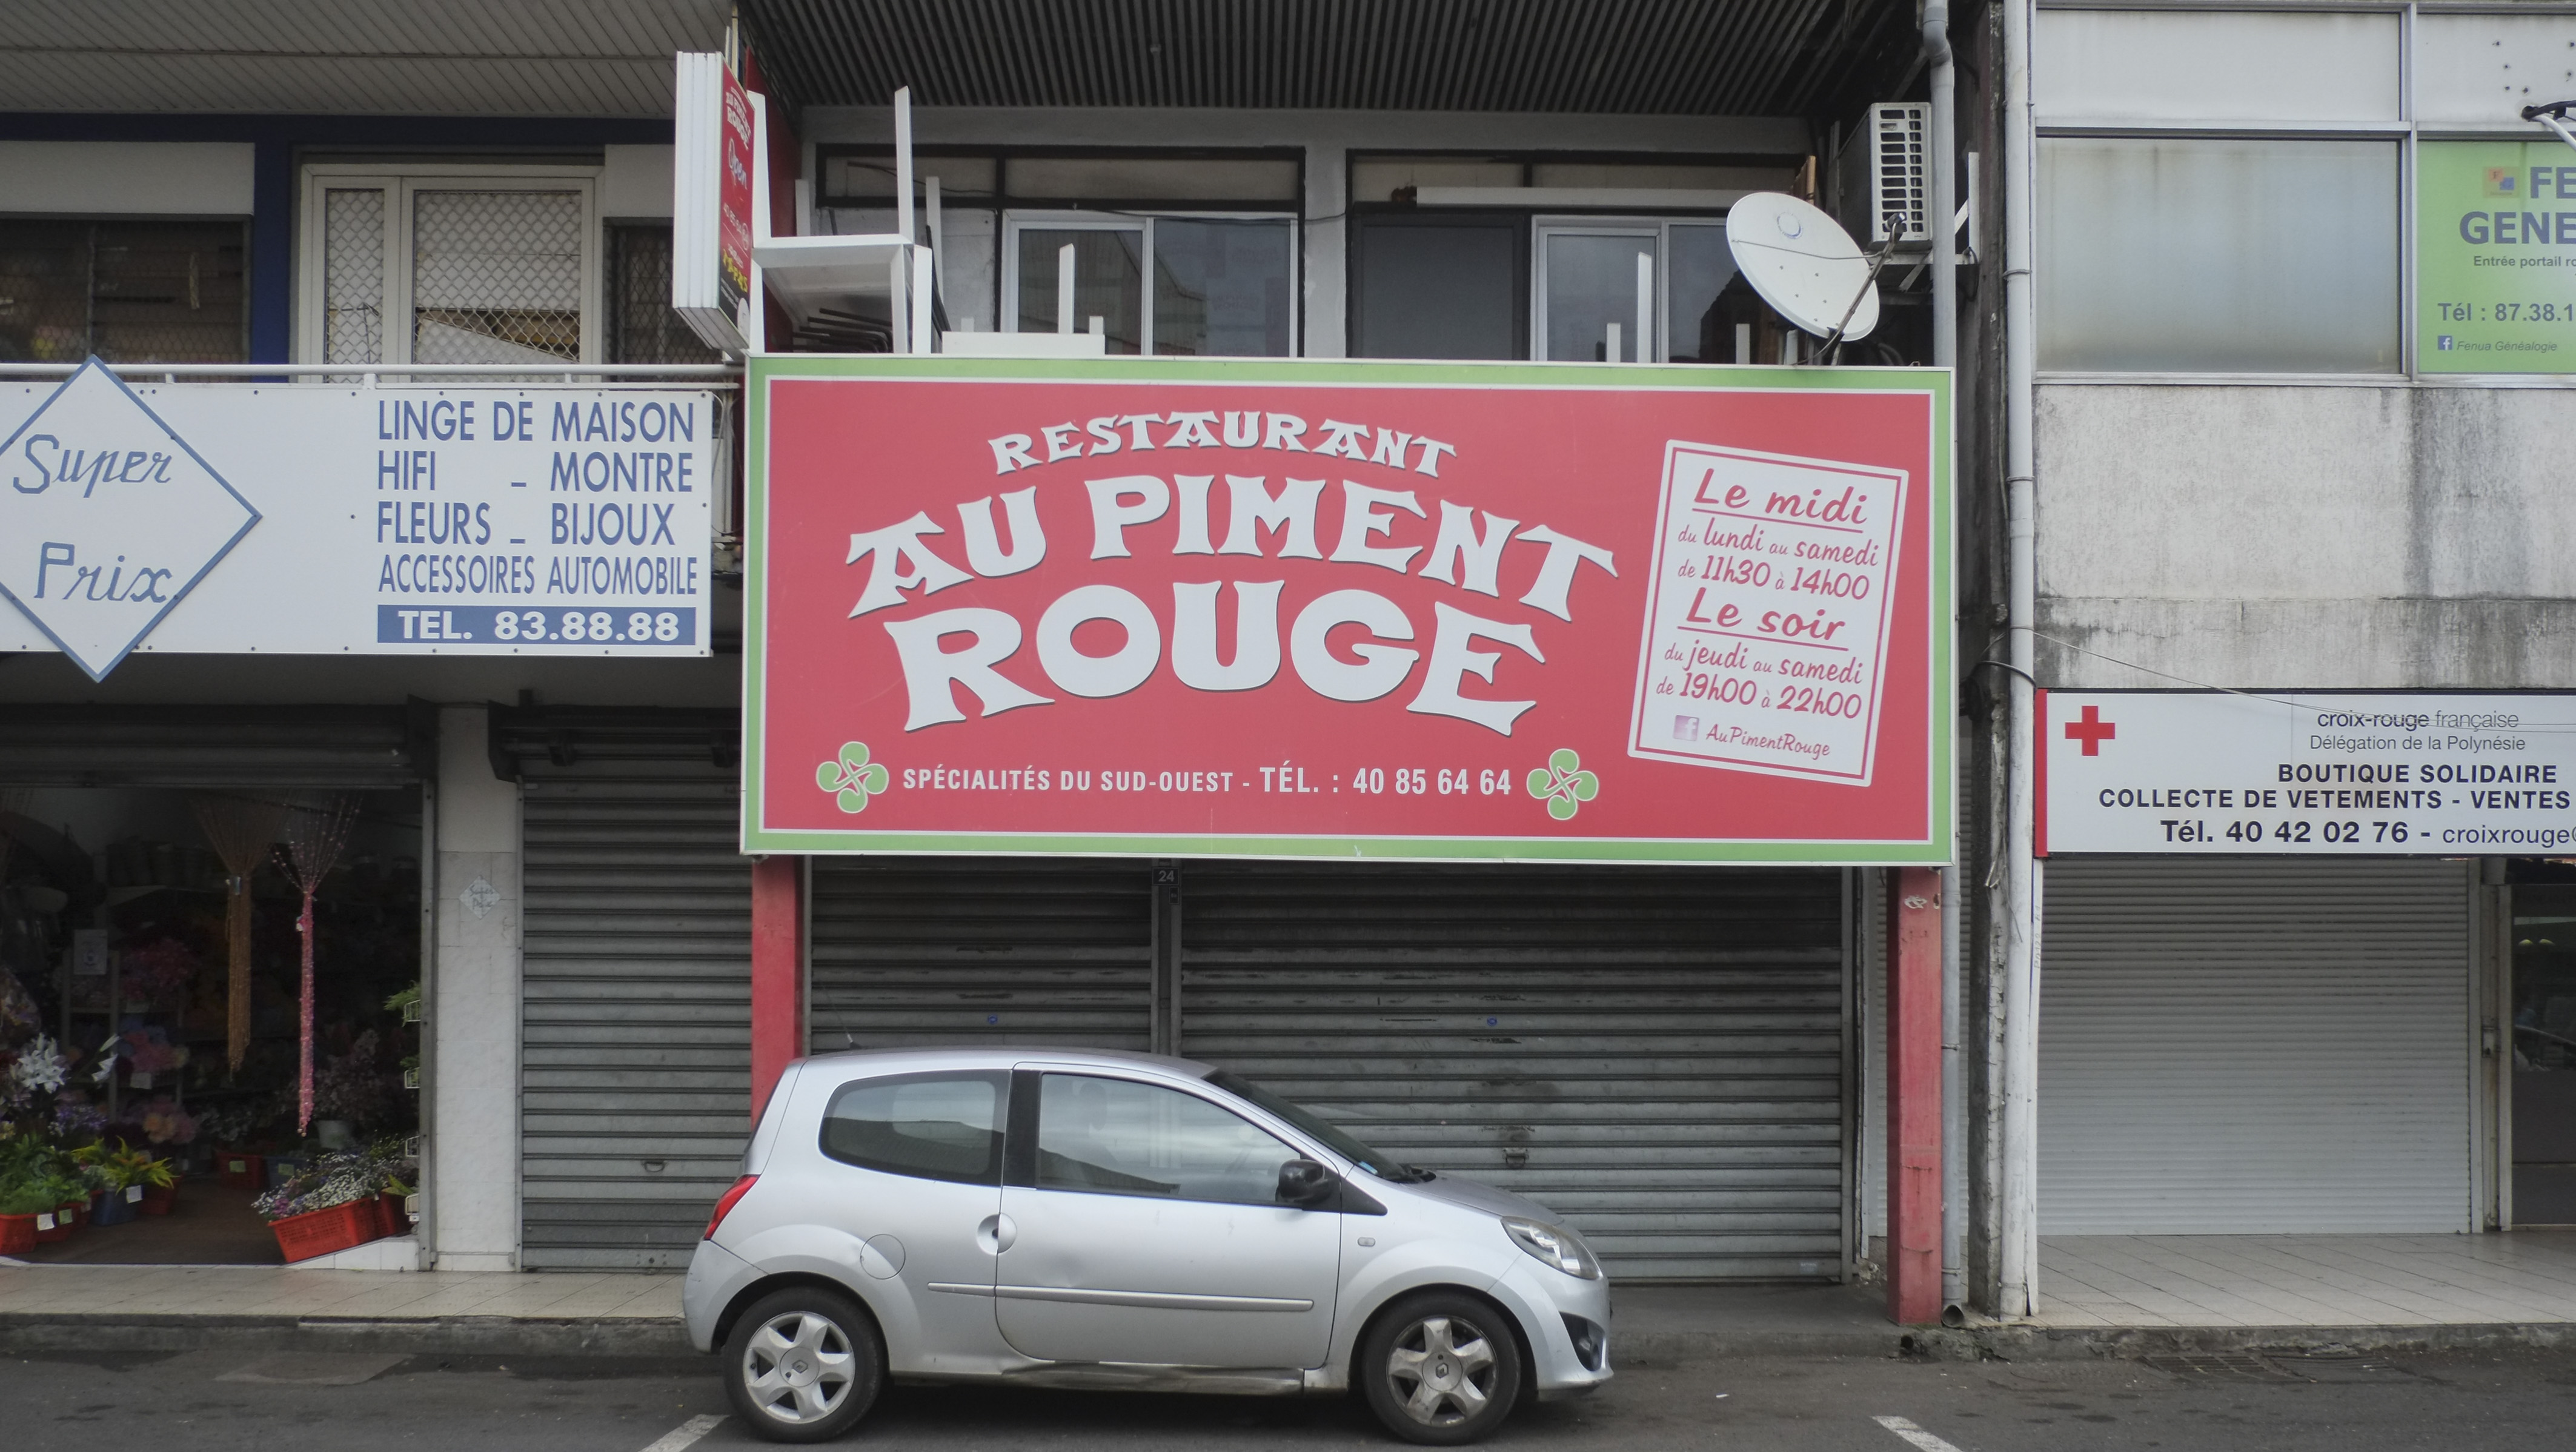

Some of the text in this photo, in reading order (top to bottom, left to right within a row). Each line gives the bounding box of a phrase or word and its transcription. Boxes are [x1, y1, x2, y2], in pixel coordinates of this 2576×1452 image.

[2530, 167, 2576, 199] FE
[2460, 211, 2576, 245] GENE
[2474, 256, 2515, 267] Entrée
[2520, 256, 2561, 268] portail
[2438, 302, 2472, 322] Tél
[2495, 303, 2572, 322] 87.38.1
[2457, 340, 2491, 351] Fenua
[2494, 340, 2557, 354] Généalogie
[379, 400, 693, 442] LINGE DE MAISON
[988, 411, 1456, 477] RESTAURANT
[13, 434, 172, 498] Super
[379, 451, 435, 490] HIFI
[551, 452, 692, 492] MONTRE
[1695, 468, 1867, 524] Le midi
[378, 502, 490, 545] FLEURS
[552, 503, 675, 545] BIJOUX
[1678, 517, 1879, 566] du lundi au samedi
[846, 474, 1618, 622] AU PIMENT
[33, 542, 172, 603] Prix
[379, 554, 697, 595] ACCESSOIRES AUTOMOBILE
[1678, 555, 1870, 600] de 11h30 à 14h00
[398, 611, 679, 641] TEL. 83.88.88
[1686, 587, 1845, 640] Le soir
[884, 580, 1545, 736] ROUGE
[1664, 639, 1863, 684] du jeudi au samedi
[1656, 672, 1862, 718] de 19h00 à 22h00
[1705, 723, 1830, 760] AuPimentRouge
[2317, 710, 2519, 732] croix-rouge française
[2310, 735, 2526, 752] Délégation de la Polynésie
[903, 764, 1050, 791] SPÉCIALITÉS
[1061, 771, 1090, 791] DU
[1101, 771, 1233, 792] SUD-OUEST
[1260, 760, 1319, 793] TÉL.
[1353, 767, 1384, 794] 40
[1395, 768, 1426, 795] 85
[1438, 768, 1469, 795] 64
[1479, 769, 1512, 795] 64
[2279, 763, 2556, 784] BOUTIQUE SOLIDAIRE
[2099, 788, 2233, 808] COLLECTE
[2245, 789, 2277, 808] DE
[2287, 789, 2442, 809] VETEMENTS
[2471, 790, 2571, 809] VENTES
[2160, 820, 2213, 843] Tél.
[2226, 820, 2263, 843] 40
[2274, 821, 2311, 843] 42
[2323, 821, 2360, 843] 02
[2373, 821, 2408, 843] 76
[2443, 824, 2576, 847] croixrouge
[1158, 870, 1175, 882] 24
